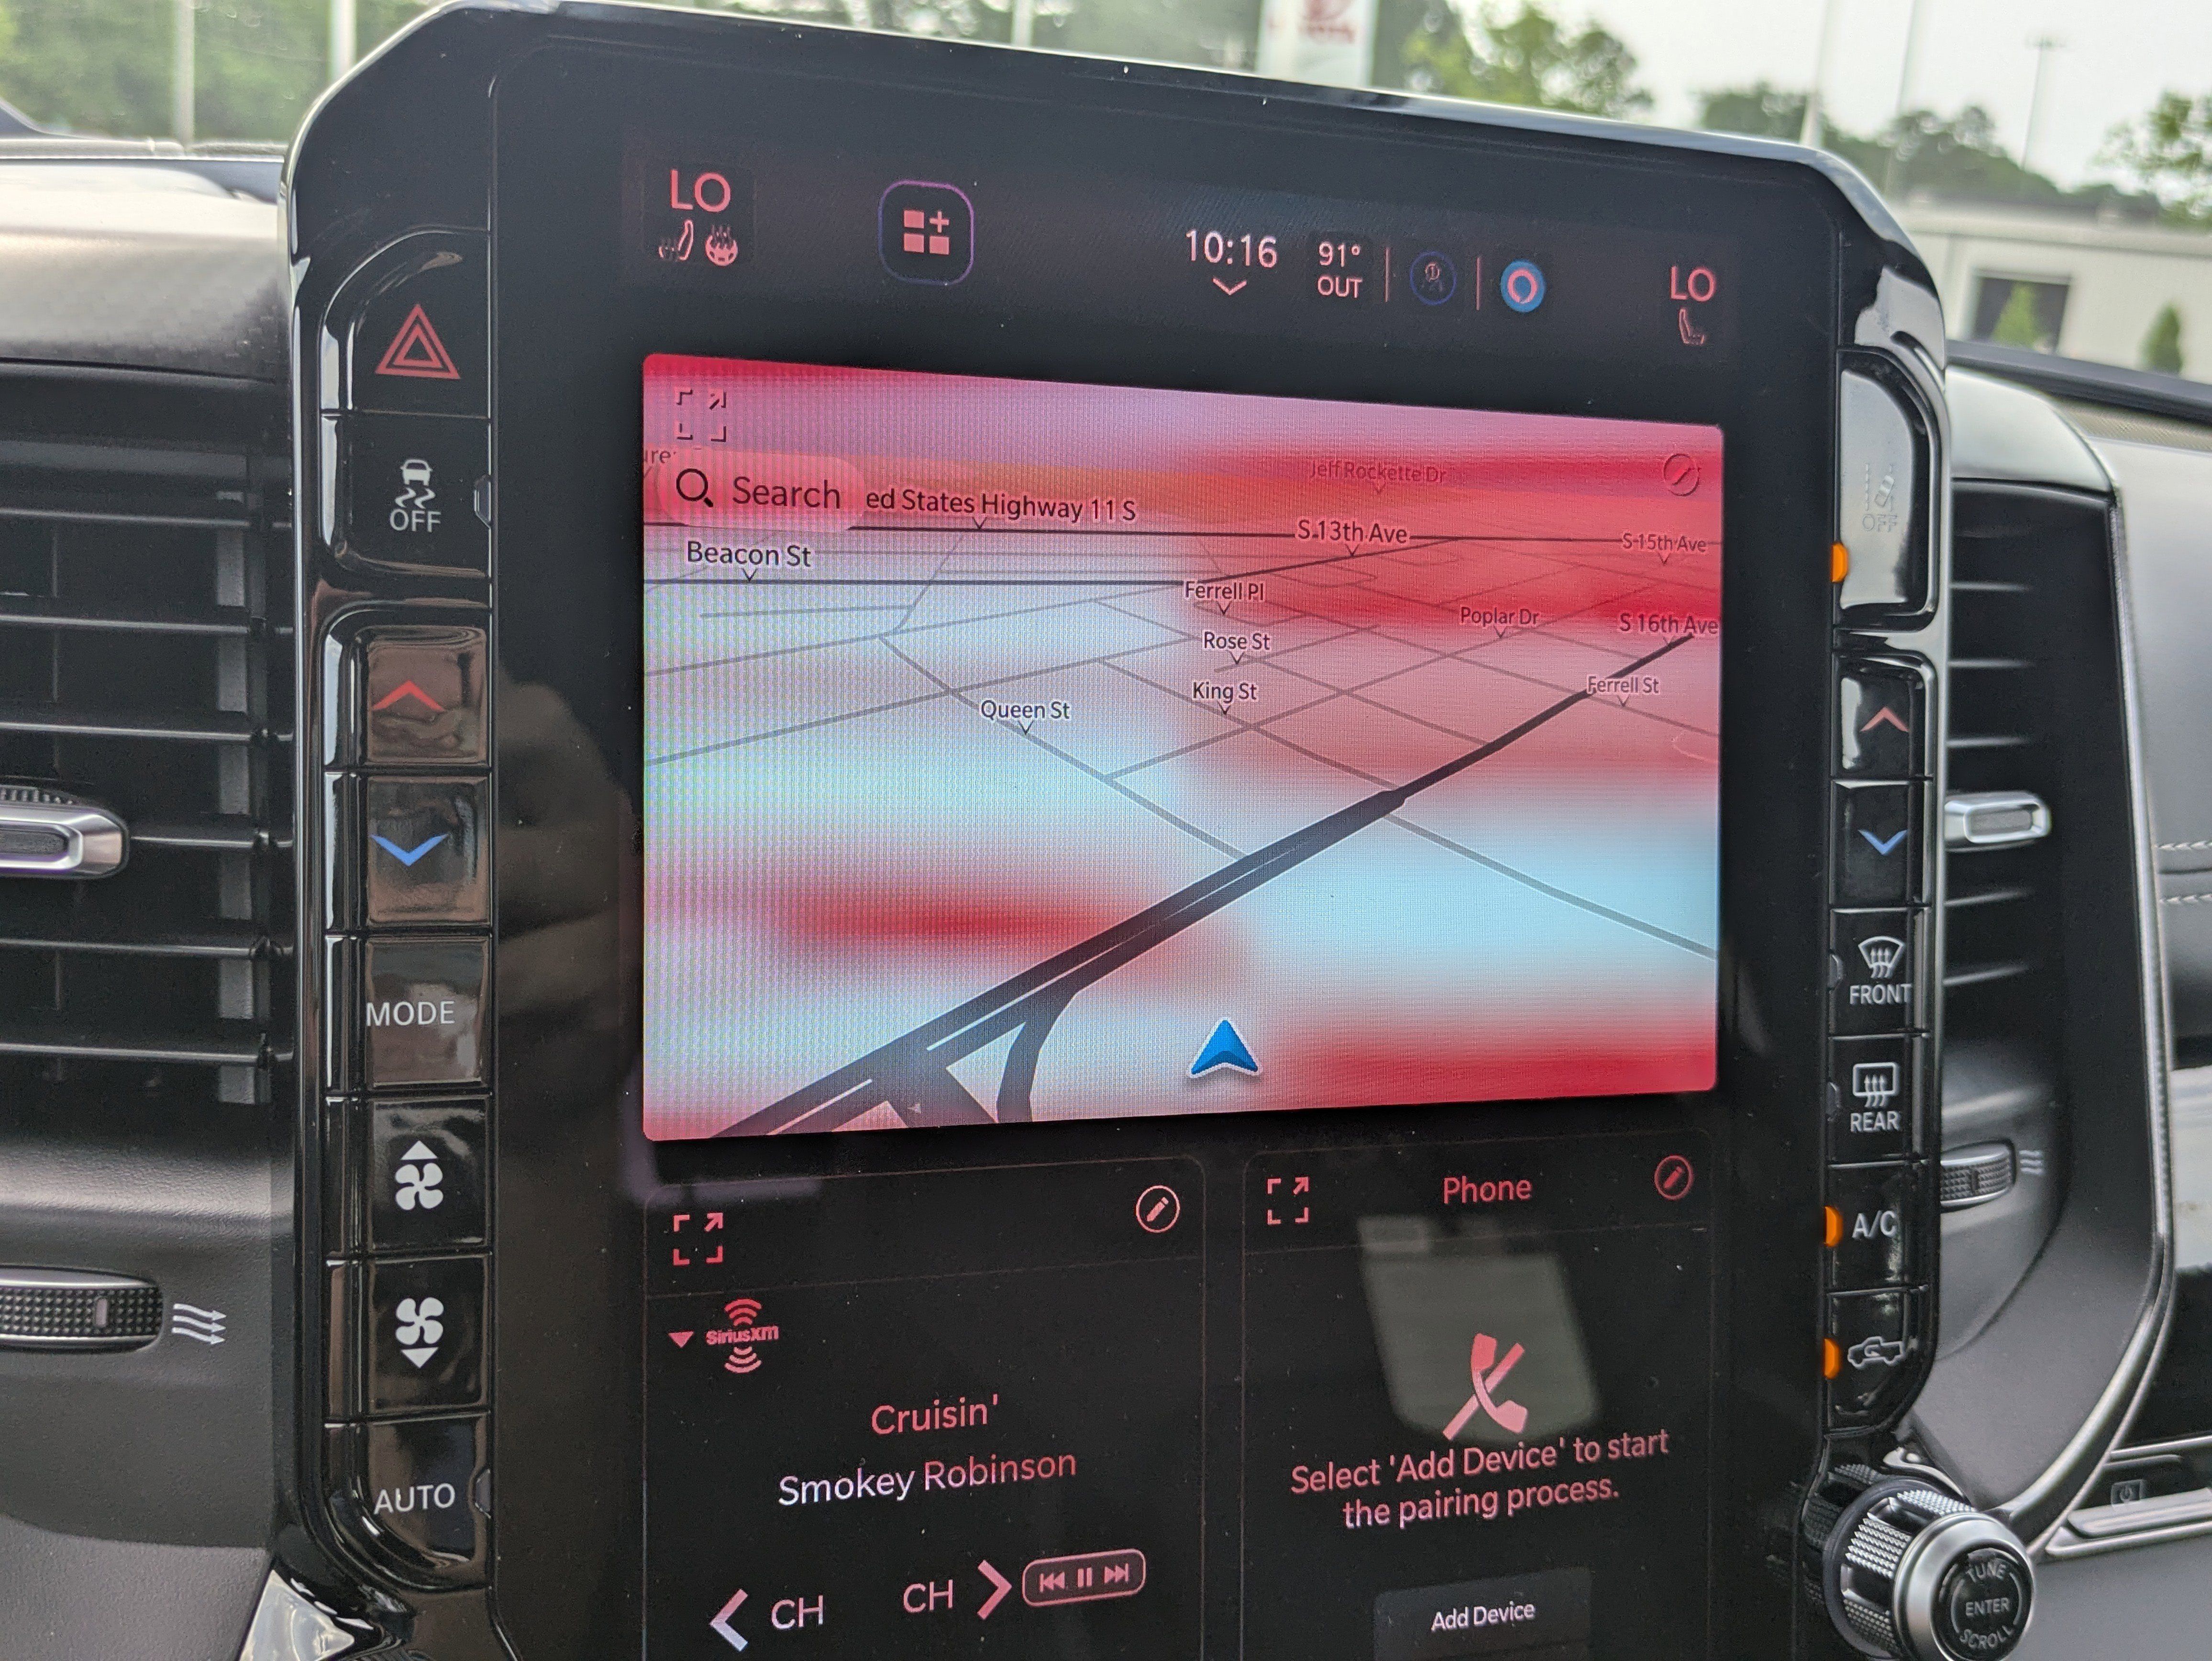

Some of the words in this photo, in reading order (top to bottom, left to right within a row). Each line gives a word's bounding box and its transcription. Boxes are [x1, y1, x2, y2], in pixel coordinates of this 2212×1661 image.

[671, 169, 731, 212] LO
[1185, 229, 1278, 268] 10:16
[1317, 276, 1363, 299] OUT
[1670, 266, 1715, 302] LO
[1311, 460, 1340, 478] Jeff
[1426, 466, 1447, 483] Dr
[733, 476, 841, 509] Search
[866, 488, 895, 509] ed
[901, 489, 975, 513] States
[982, 493, 1083, 523] Highway
[1091, 499, 1114, 520] 11
[1122, 500, 1136, 521] S
[389, 508, 442, 533] OFF
[1369, 523, 1407, 544] Ave
[687, 541, 779, 565] Beacon
[786, 545, 812, 567] St
[1677, 538, 1706, 553] Ave
[1184, 581, 1242, 600] Ferrell
[1460, 607, 1515, 626] Poplar
[1520, 609, 1539, 624] Dr
[1620, 613, 1631, 632] S
[1638, 614, 1679, 633] 16th
[1684, 616, 1719, 635] Ave
[1204, 631, 1247, 650] Rose
[1252, 632, 1271, 650] St
[1193, 681, 1234, 704] King
[1238, 683, 1257, 700] St
[1588, 676, 1638, 694] Ferrell
[1642, 678, 1659, 694] St
[981, 699, 1045, 720] Queen
[1051, 701, 1070, 719] St
[1849, 983, 1913, 1005] FRONT
[366, 1000, 455, 1027] MODE
[1850, 1110, 1901, 1133] REAR
[1443, 1176, 1531, 1204] Phone
[1852, 1209, 1897, 1240] A/C
[871, 1394, 998, 1435] Cruisin'
[1290, 1459, 1382, 1495] Select
[1390, 1449, 1454, 1484] 'Add
[1463, 1437, 1565, 1476] Device'
[1573, 1436, 1599, 1463] to
[1608, 1428, 1670, 1459] start
[778, 1467, 916, 1506] Smokey
[924, 1453, 1077, 1491] Robinson
[373, 1483, 455, 1515] AUTO
[1342, 1500, 1390, 1529] the
[1399, 1486, 1499, 1529] pairing
[1507, 1476, 1619, 1516] process.
[1966, 1561, 2007, 1583] TUNE
[903, 1579, 953, 1613] CH
[1965, 1597, 2010, 1617] ENTER
[771, 1595, 824, 1630] CH
[1431, 1606, 1469, 1631] Add
[1473, 1600, 1536, 1626] Device
[1959, 1624, 2013, 1650] SCROLL
